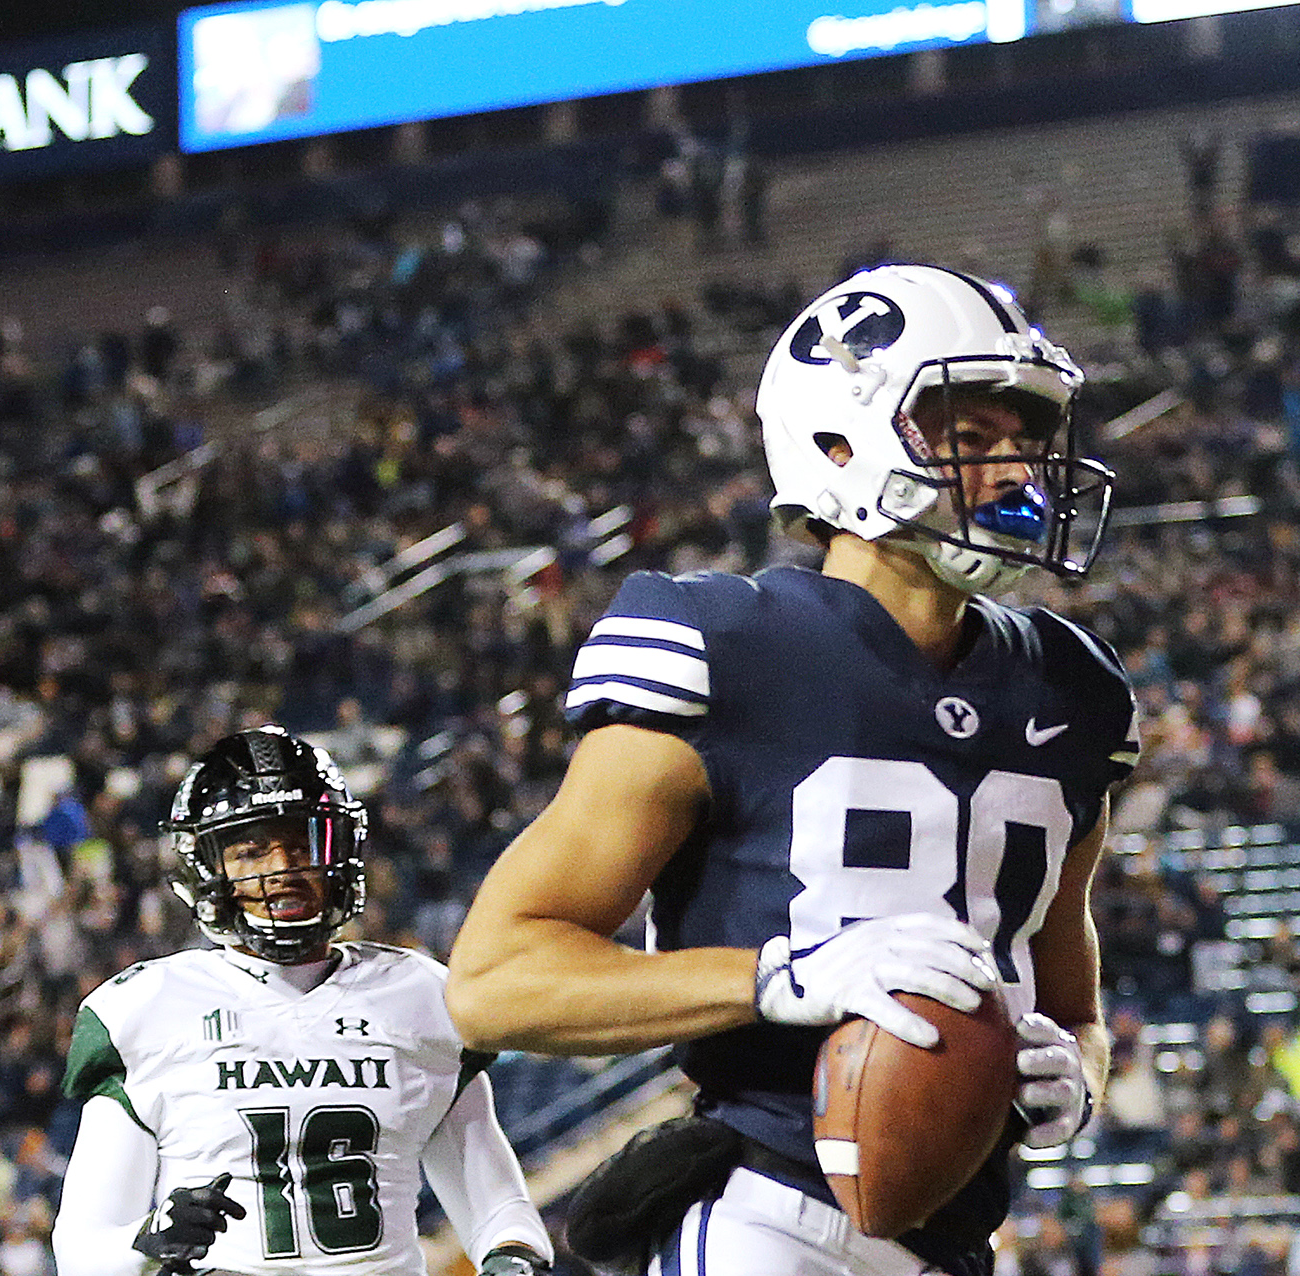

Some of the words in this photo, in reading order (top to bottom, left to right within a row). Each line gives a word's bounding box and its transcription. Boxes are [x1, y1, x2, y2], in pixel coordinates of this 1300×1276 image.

[943, 703, 971, 732] Y
[789, 755, 1073, 1020] 80
[238, 1104, 385, 1260] 16
